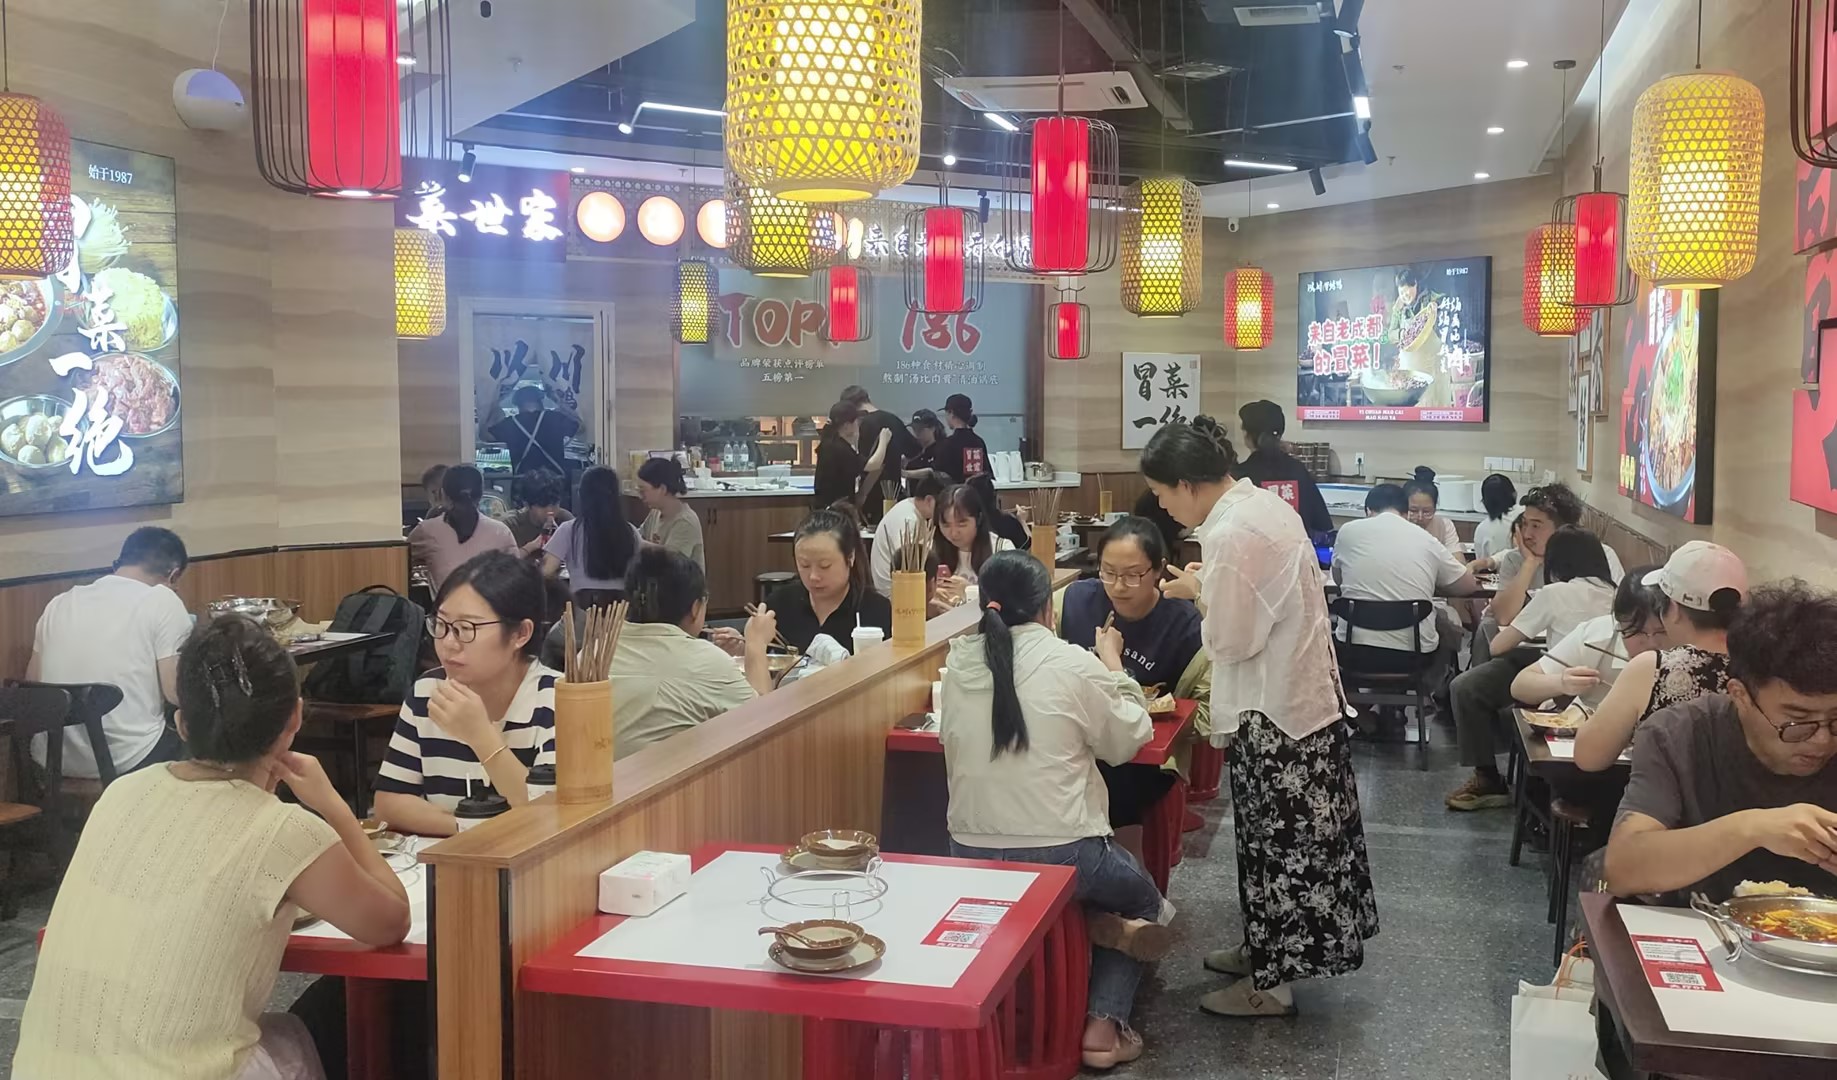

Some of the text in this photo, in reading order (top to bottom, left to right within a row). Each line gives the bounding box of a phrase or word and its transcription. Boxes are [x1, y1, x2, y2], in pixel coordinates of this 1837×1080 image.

[88, 164, 133, 184] 始于1987
[718, 291, 841, 349] TOP
[900, 297, 982, 356] 186
[1308, 314, 1383, 345] 来自老成都
[761, 372, 804, 383] 五榜第一
[1133, 362, 1189, 401] 冒菜
